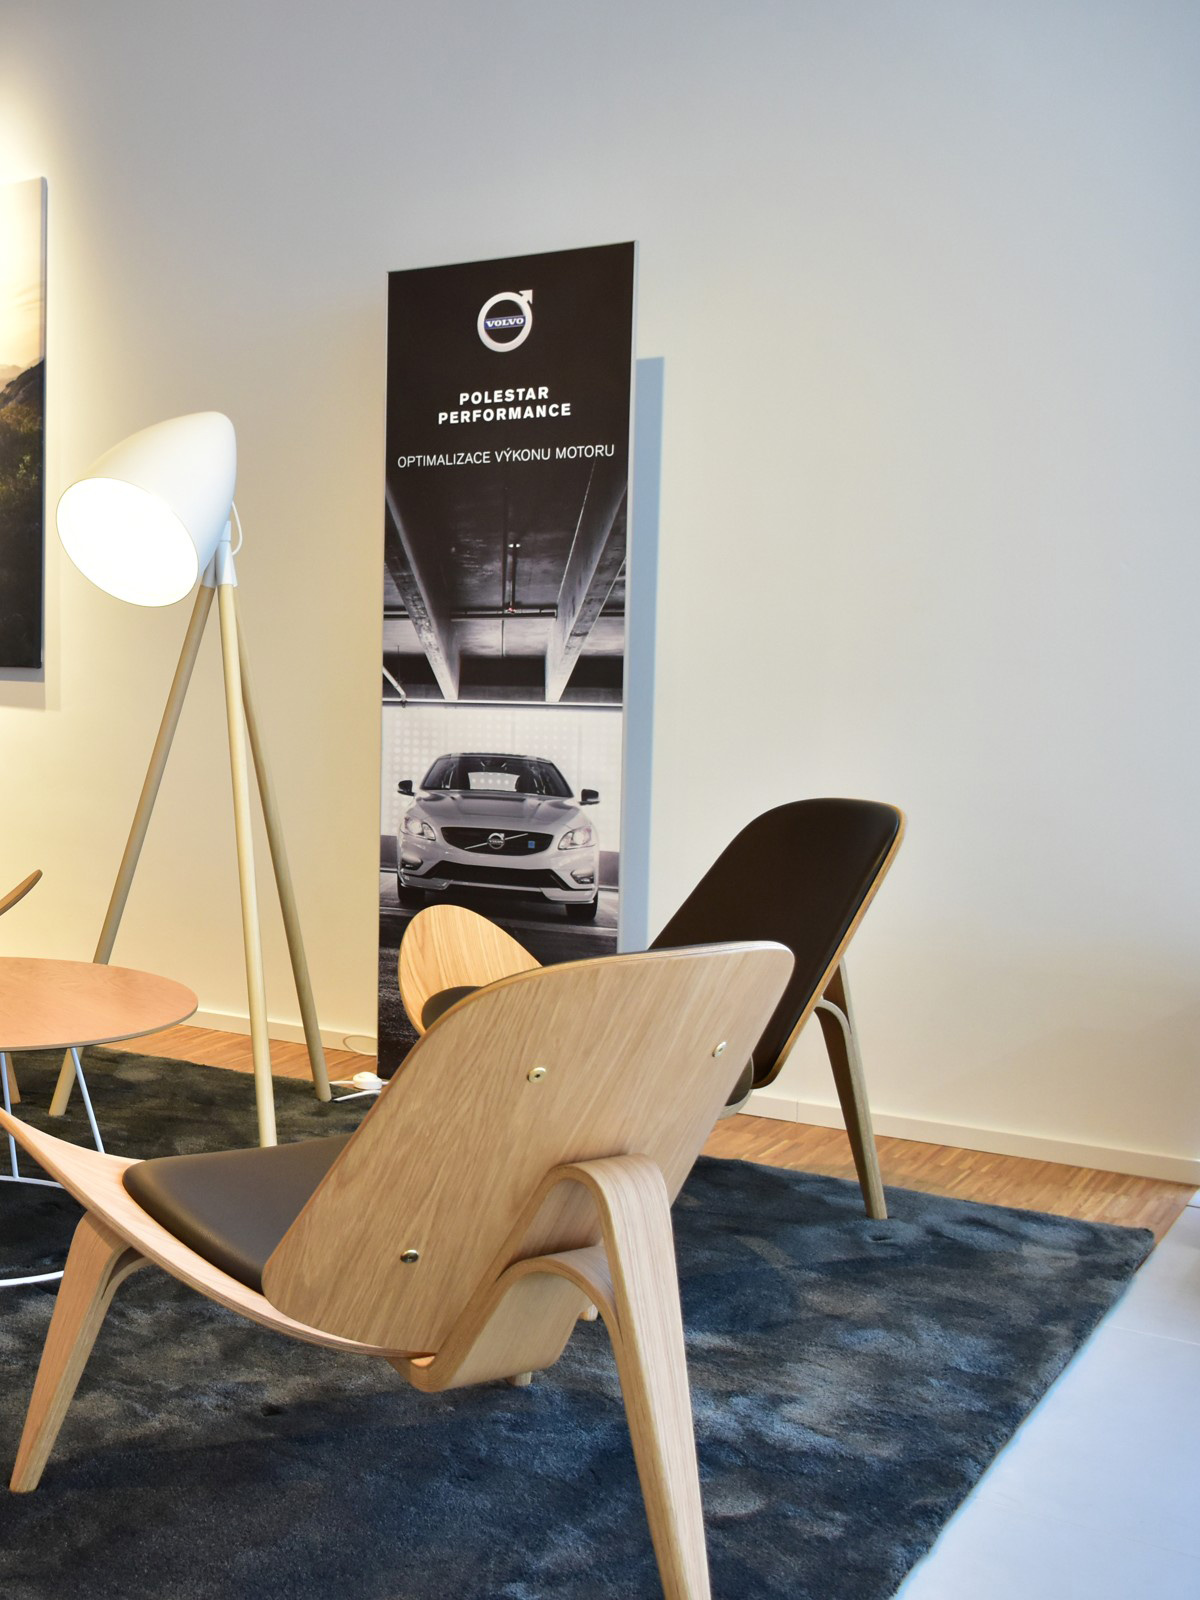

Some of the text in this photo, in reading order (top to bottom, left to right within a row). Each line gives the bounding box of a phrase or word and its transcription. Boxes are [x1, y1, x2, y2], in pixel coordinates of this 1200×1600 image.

[485, 317, 524, 328] VOLVO
[459, 386, 549, 406] POLESTAR
[438, 403, 571, 425] PERFORMANCE
[397, 444, 615, 469] OPTIMALIZACE VÝKONU MOTORU
